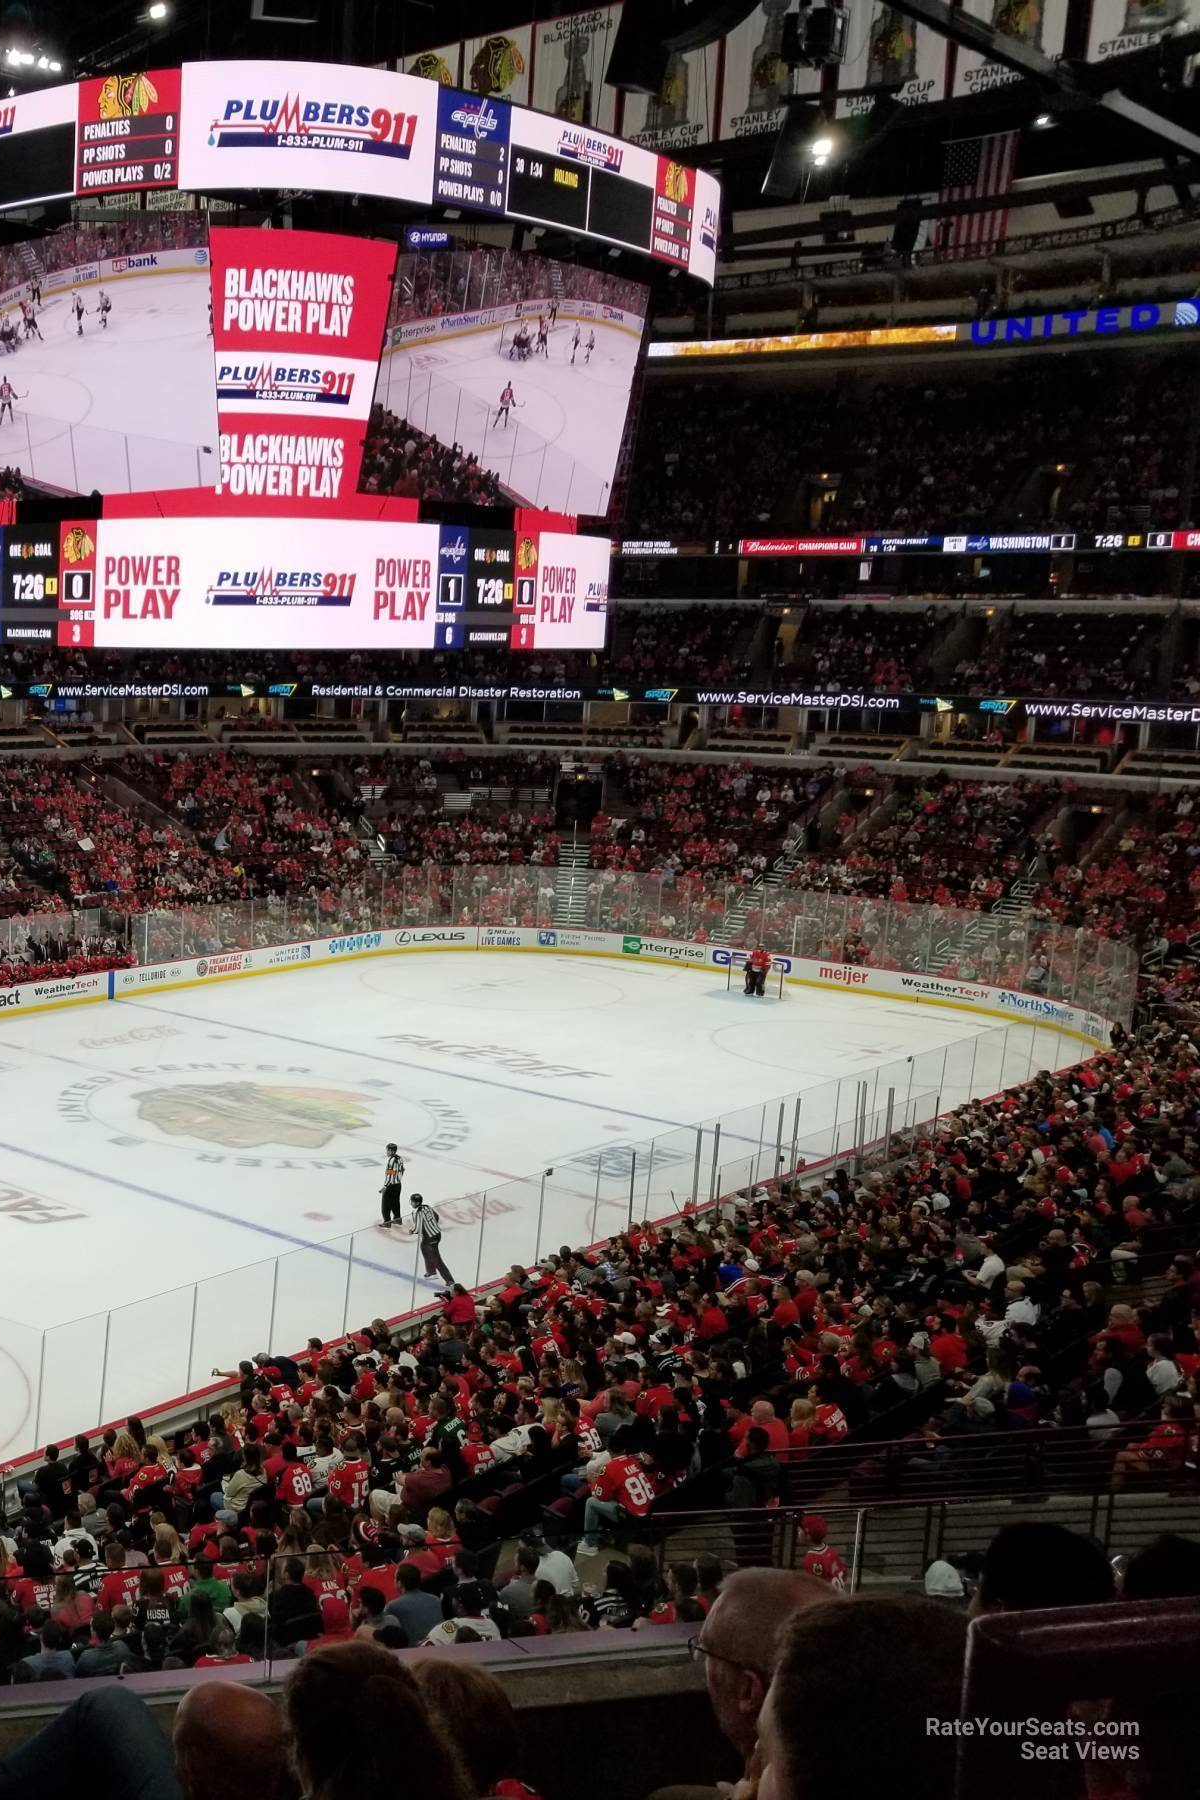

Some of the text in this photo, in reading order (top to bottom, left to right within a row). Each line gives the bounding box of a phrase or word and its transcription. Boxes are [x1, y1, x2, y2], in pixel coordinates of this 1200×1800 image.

[556, 12, 602, 31] CHICAGO
[544, 20, 613, 43] BLACKHAWKS
[84, 115, 173, 141] PENALTIES 0
[730, 110, 780, 128] STANLEY
[680, 124, 703, 136] CUP
[83, 139, 172, 164] PP SHOTS 0
[277, 135, 364, 151] 1-833-PLUM-911
[440, 133, 504, 161] PENALTIES 2
[82, 163, 171, 187] POWER PLAYS 0/2
[439, 159, 503, 184] PP SHOTS 0
[530, 162, 579, 188] 1:34 HOLDING
[438, 180, 463, 199] POWER
[463, 185, 484, 203] PLAYS
[421, 232, 447, 242] HYUNDAI
[127, 254, 158, 268] bank
[224, 268, 354, 305] BLACKHAWKS
[223, 299, 353, 337] POWER PLAY
[971, 304, 1161, 344] UNITED
[255, 390, 316, 402] 1-833-PLUM-911
[220, 434, 344, 467] BLACKHAWKS
[215, 464, 343, 498] POWER PLAY
[9, 544, 21, 557] ONE
[34, 544, 51, 557] GOAL
[747, 541, 857, 552] Budweiser CHAMPIONS CLUB
[989, 534, 1165, 549] WASHINGTON 1 7:26 0
[474, 548, 485, 561] ONE
[496, 550, 510, 563] GOAL
[104, 556, 180, 586] POWER
[375, 558, 431, 588] POWER
[542, 565, 576, 595] POWER
[13, 574, 44, 600] 7:26
[72, 574, 81, 599] 0
[448, 579, 454, 601] 1
[477, 579, 503, 604] 7:26
[522, 580, 529, 603] 0
[103, 589, 181, 619] PLAY
[255, 597, 318, 606] 1-833-PLUM-911
[373, 591, 430, 620] PLAY
[540, 596, 575, 624] PLAY
[70, 609, 83, 621] SOG
[444, 612, 455, 623] SOG
[7, 628, 51, 638] BLACKHAWKS.COM
[72, 625, 80, 642] 3
[445, 627, 452, 644] 6
[520, 628, 526, 645] 3
[58, 683, 208, 697] www.ServiceMasterDSI.com
[312, 684, 581, 700] Residential & Commercial Disaster Restoration
[697, 691, 900, 709] www.ServiceMasterDSI.com
[413, 932, 465, 941] LEXUS
[481, 937, 520, 946] LIVE GAMES
[208, 954, 243, 965] FREAKY FAST
[269, 953, 299, 963] AIRLINES
[275, 947, 299, 956] UNITED
[138, 969, 167, 982] TELLURIDE
[208, 962, 241, 975] REWARDS
[819, 966, 868, 984] meijer
[34, 978, 98, 996] WeatherTech
[901, 978, 988, 999] WeatherTech
[1007, 993, 1075, 1021] NorthShore
[57, 1063, 312, 1123] UNITED CENTER
[292, 1474, 311, 1496] 88
[169, 1571, 185, 1584] KANE
[321, 1580, 339, 1592] KANE
